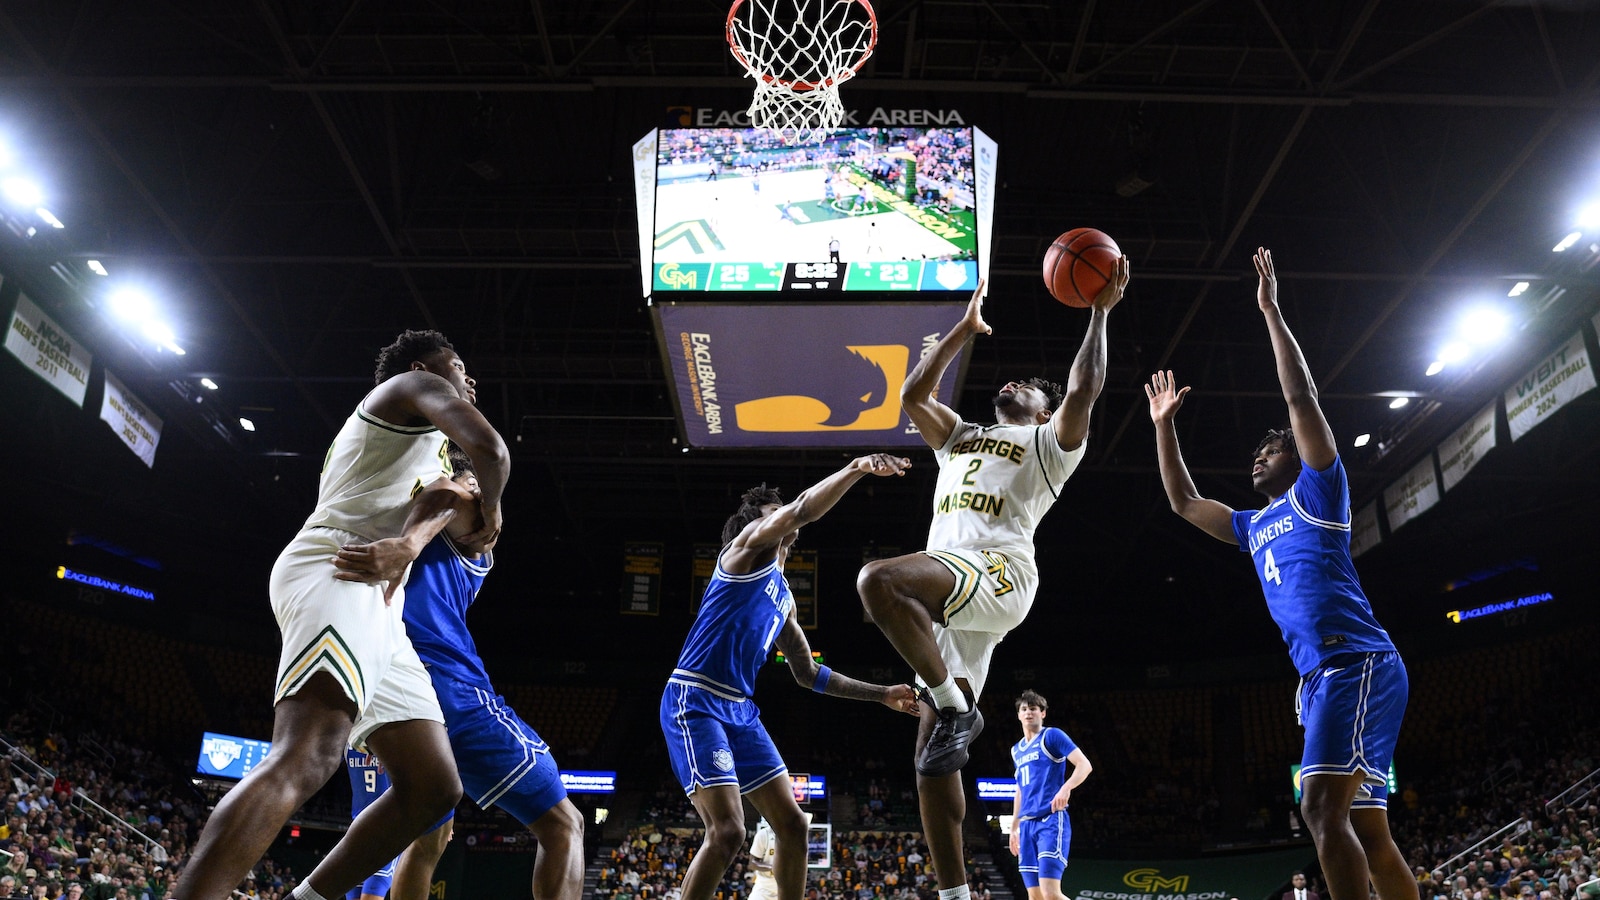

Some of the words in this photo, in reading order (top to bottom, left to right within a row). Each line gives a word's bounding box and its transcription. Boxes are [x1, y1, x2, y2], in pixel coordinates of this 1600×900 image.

[866, 107, 966, 126] ARENA
[659, 262, 697, 290] GM
[720, 264, 750, 283] 25
[879, 264, 909, 282] 23
[13, 317, 39, 347] MEN'S
[38, 340, 85, 386] BASKETBALL
[37, 320, 71, 358] NCAA
[36, 354, 58, 379] 2011
[691, 332, 718, 401] EAGLEBANK
[1516, 345, 1570, 398] WBIT
[1507, 391, 1540, 421] WOMEN'S
[1539, 357, 1587, 398] BASKETBALL
[703, 401, 723, 435] ARENA
[1536, 393, 1557, 417] 2024
[949, 437, 1026, 467] GEORGE
[961, 458, 983, 487] 2
[936, 490, 1005, 518] MASON
[1264, 548, 1282, 586] 4
[65, 568, 121, 592] EAGLEBANK
[121, 583, 155, 601] ARENA
[1460, 600, 1516, 621] EAGLEBANK
[1516, 592, 1554, 608] ARENA
[763, 614, 781, 652] 1
[364, 769, 377, 793] 9
[1020, 764, 1030, 787] 11
[1123, 867, 1190, 893] GM
[1157, 890, 1227, 900] MASON
